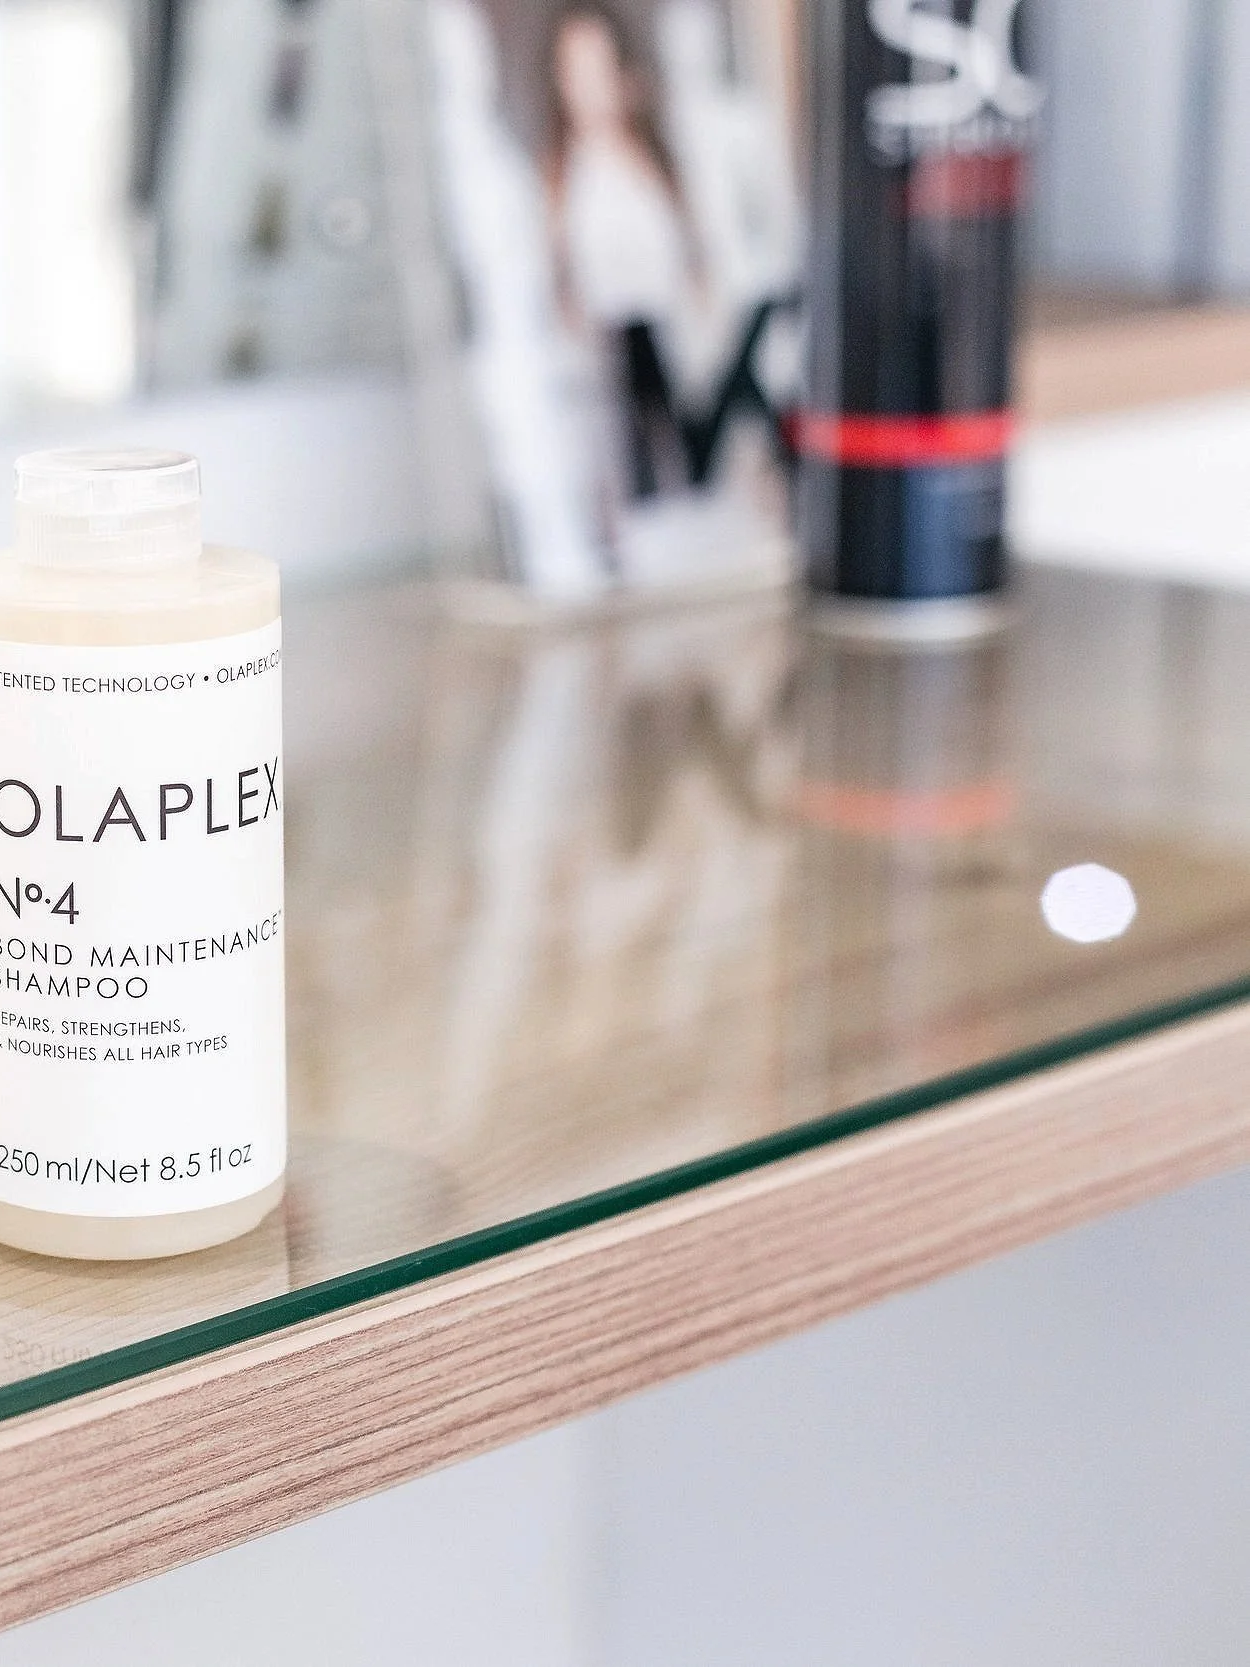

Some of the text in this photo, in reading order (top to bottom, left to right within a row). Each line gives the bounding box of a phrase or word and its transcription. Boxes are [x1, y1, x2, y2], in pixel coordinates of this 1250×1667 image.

[62, 672, 197, 694] TECHNOLOGY
[61, 1018, 188, 1037] STRENGTHENS,
[7, 1037, 97, 1061] NOURISHES
[103, 1046, 135, 1061] ALL
[141, 1043, 181, 1061] HAIR
[185, 1034, 228, 1056] TYPES
[46, 1156, 151, 1186] ml/Net
[160, 1152, 201, 1181] 8.5
[209, 1147, 222, 1173] fl
[228, 1143, 252, 1168] oz
